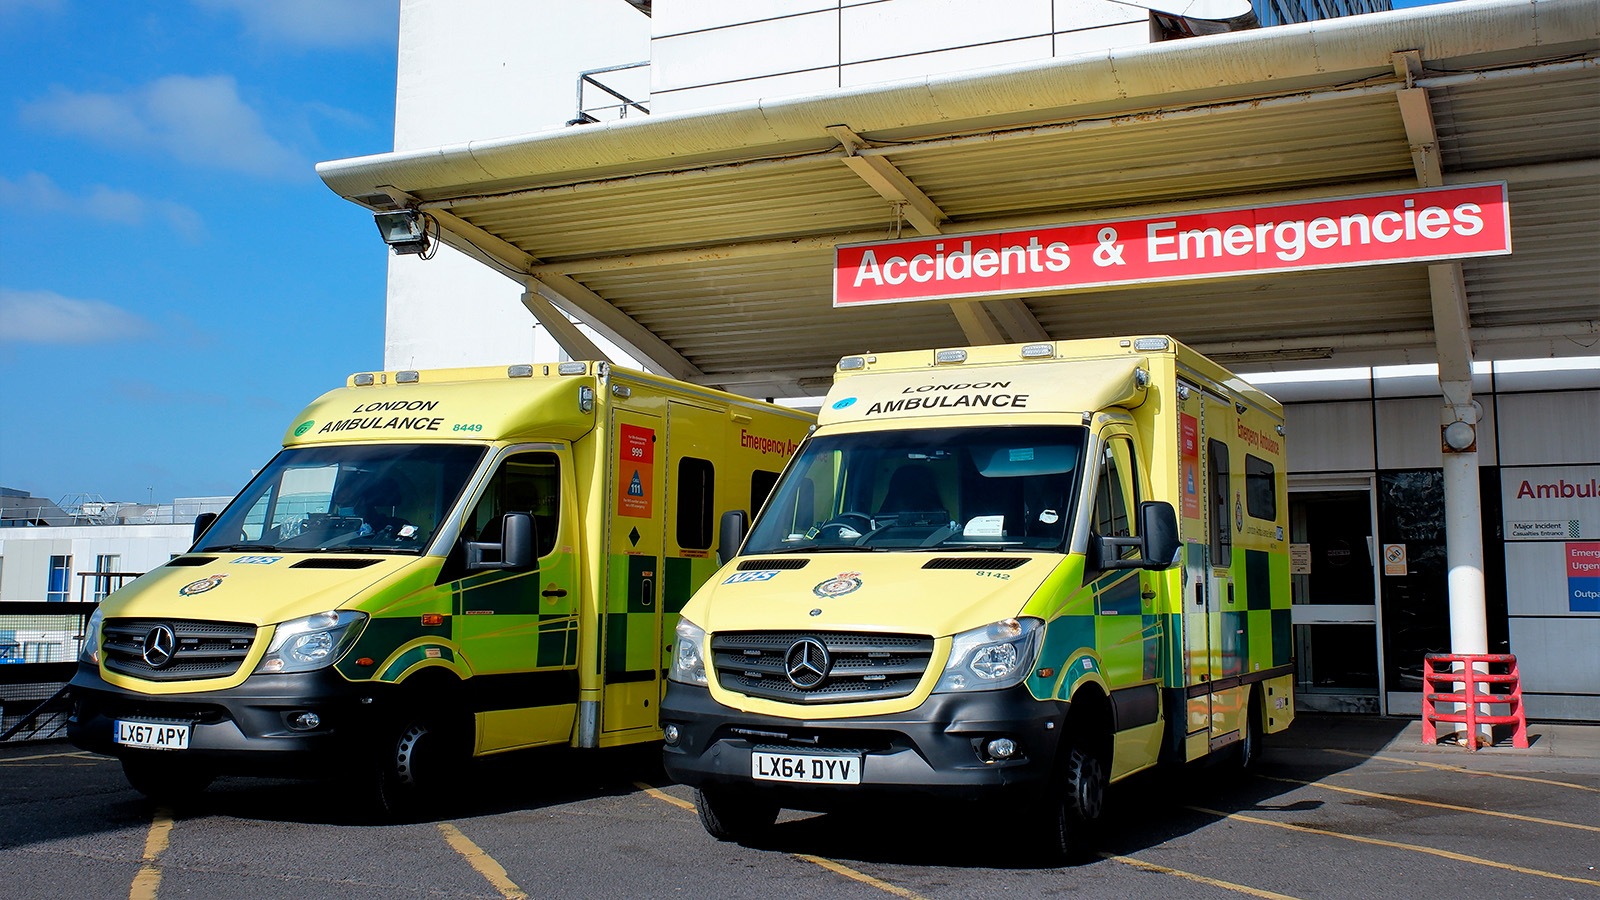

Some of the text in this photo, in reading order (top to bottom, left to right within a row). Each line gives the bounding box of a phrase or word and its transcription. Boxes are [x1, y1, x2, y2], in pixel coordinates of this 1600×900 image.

[853, 199, 1484, 288] Accidents & Emergencies
[902, 381, 1012, 394] LONDON
[352, 400, 440, 413] LONDON
[865, 394, 1029, 416] AMBULANCE
[317, 416, 445, 435] AMBULANCE
[452, 424, 483, 432] 8449
[741, 428, 785, 457] Emergency
[631, 447, 643, 457] 999
[631, 483, 641, 494] 111
[1517, 479, 1600, 499] Ambul
[231, 556, 283, 564] NHS
[723, 571, 779, 584] NHS
[976, 571, 1010, 580] 8142
[121, 724, 186, 745] LX67 APY
[759, 756, 850, 780] LX64 DYV
